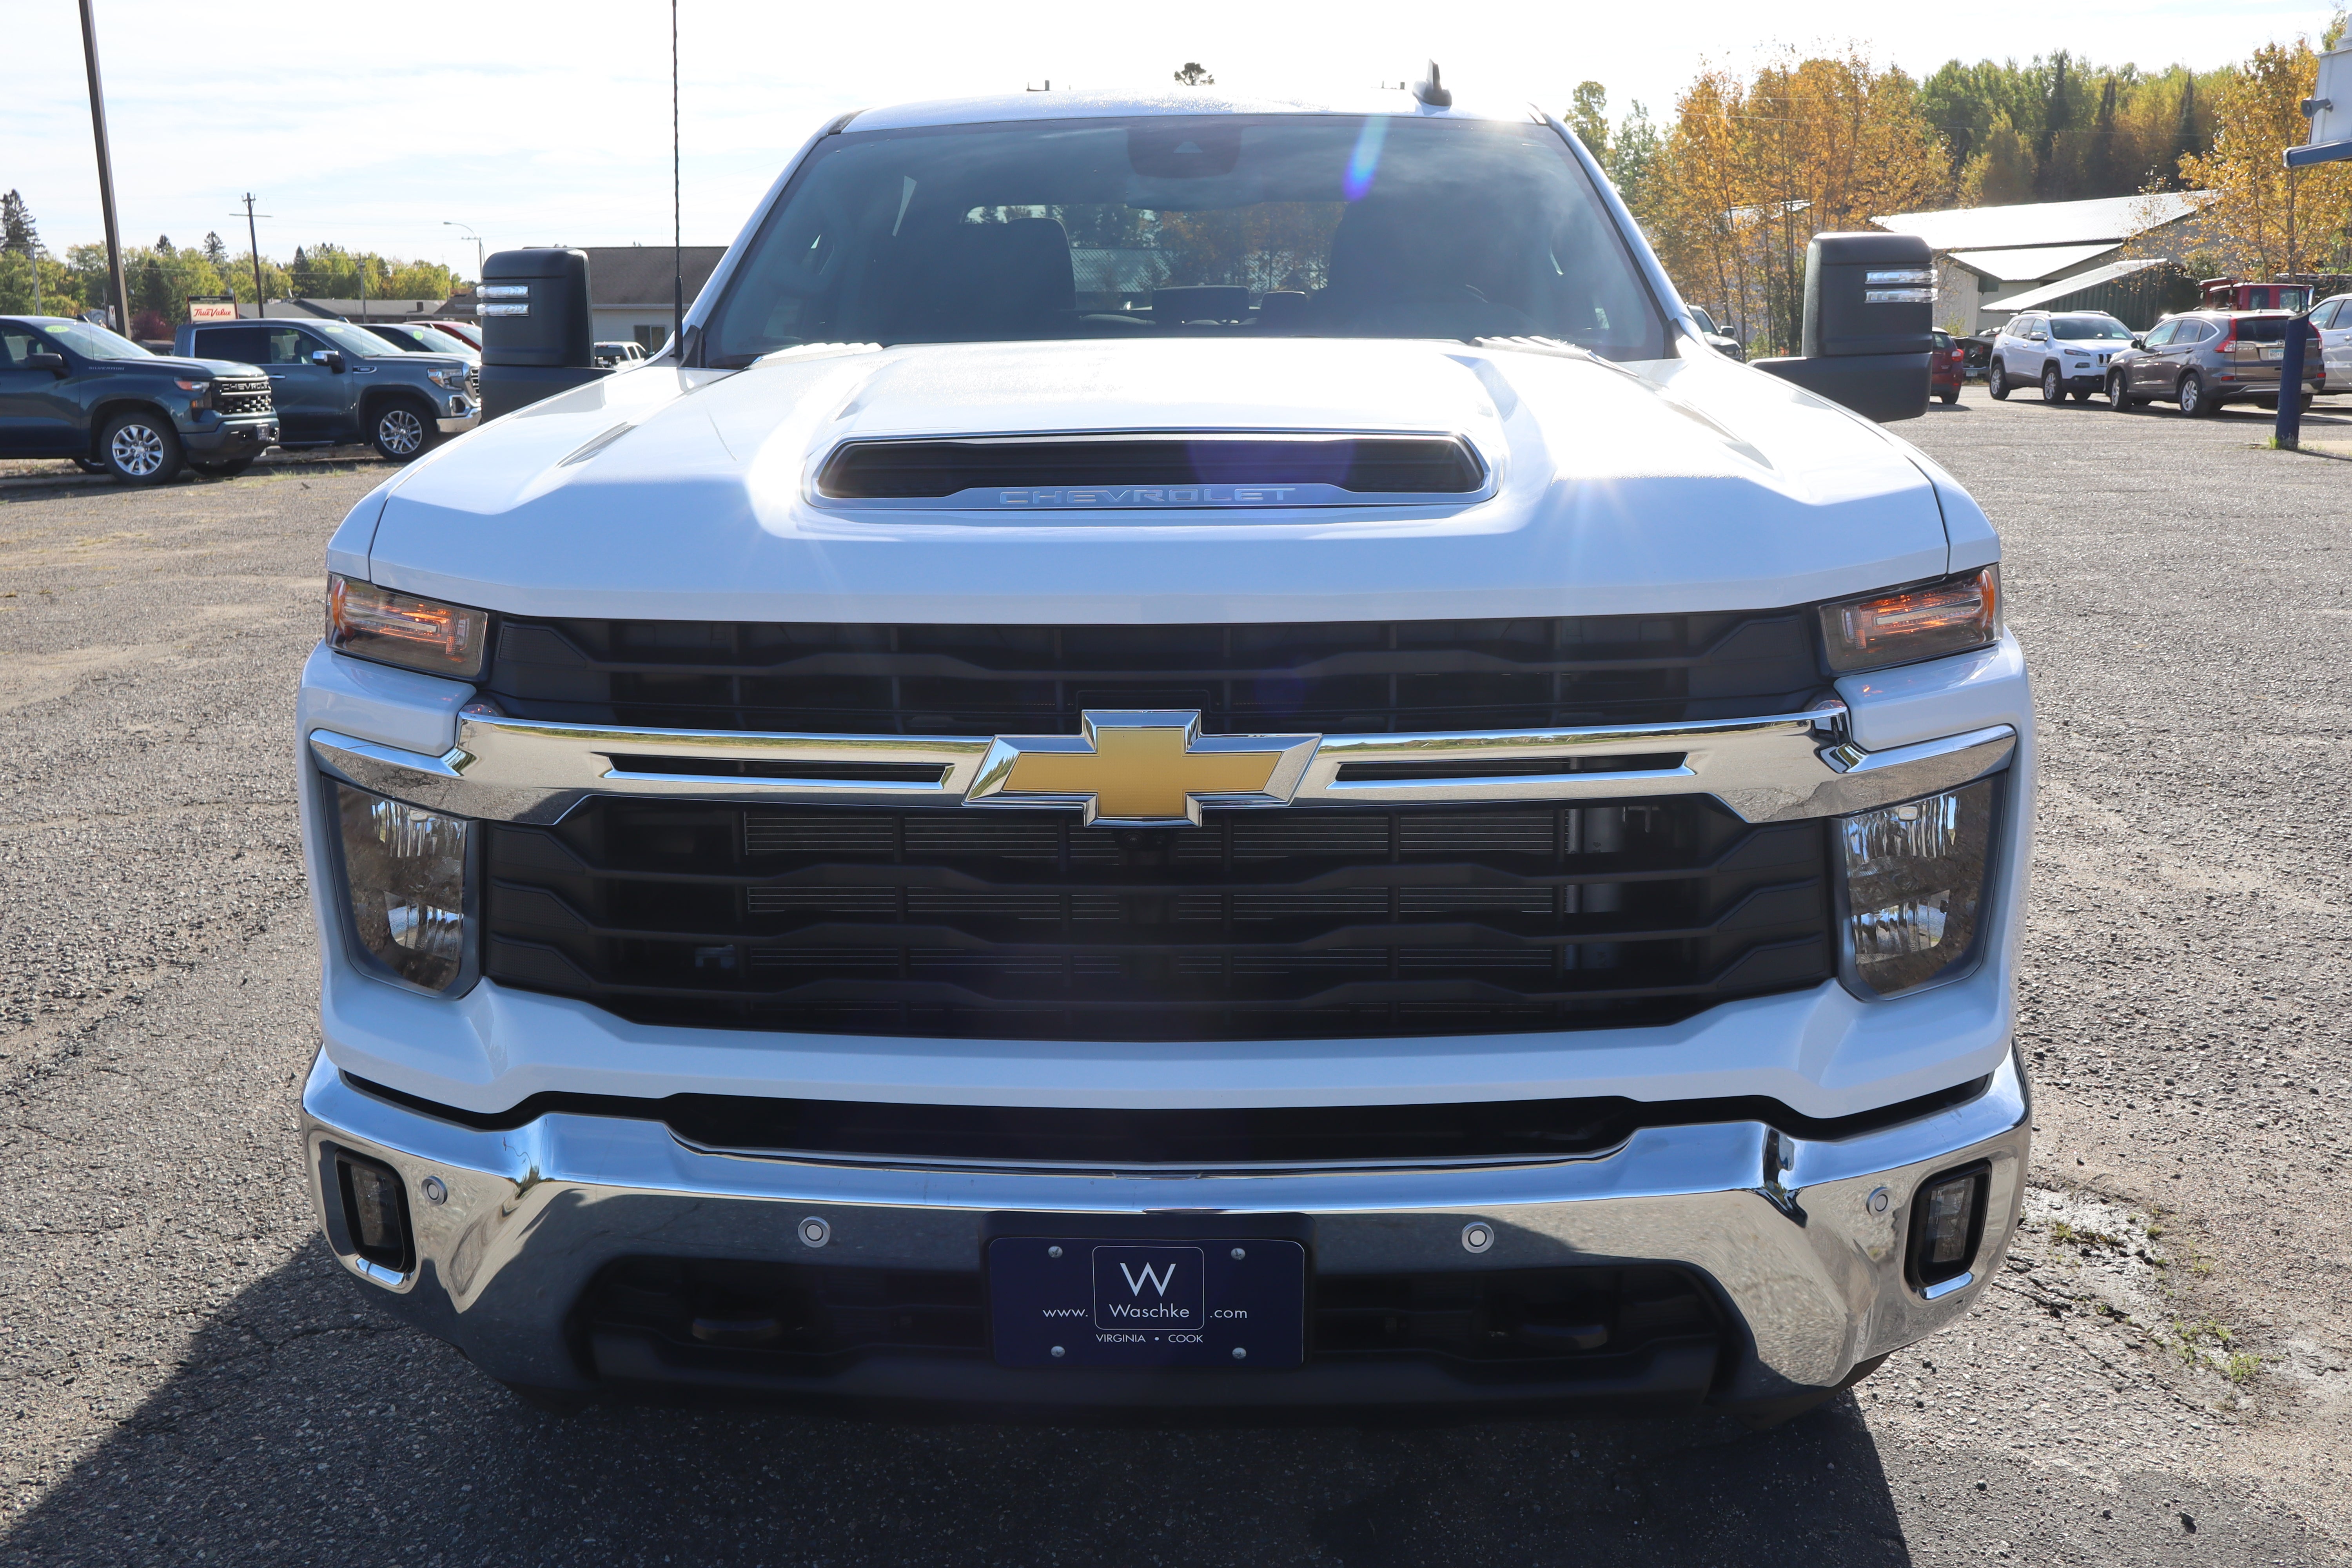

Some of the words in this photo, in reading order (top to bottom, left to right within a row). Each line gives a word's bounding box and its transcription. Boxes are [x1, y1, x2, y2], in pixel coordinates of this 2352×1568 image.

[193, 308, 210, 317] True
[206, 308, 231, 317] Value
[1000, 488, 1296, 504] CHEVROLET
[1120, 1262, 1176, 1297] W
[1042, 1309, 1088, 1318] www.
[1109, 1303, 1190, 1318] Waschke
[1210, 1310, 1247, 1318] .com
[1096, 1334, 1146, 1343] VIRGINIA
[1168, 1334, 1203, 1343] COOK
